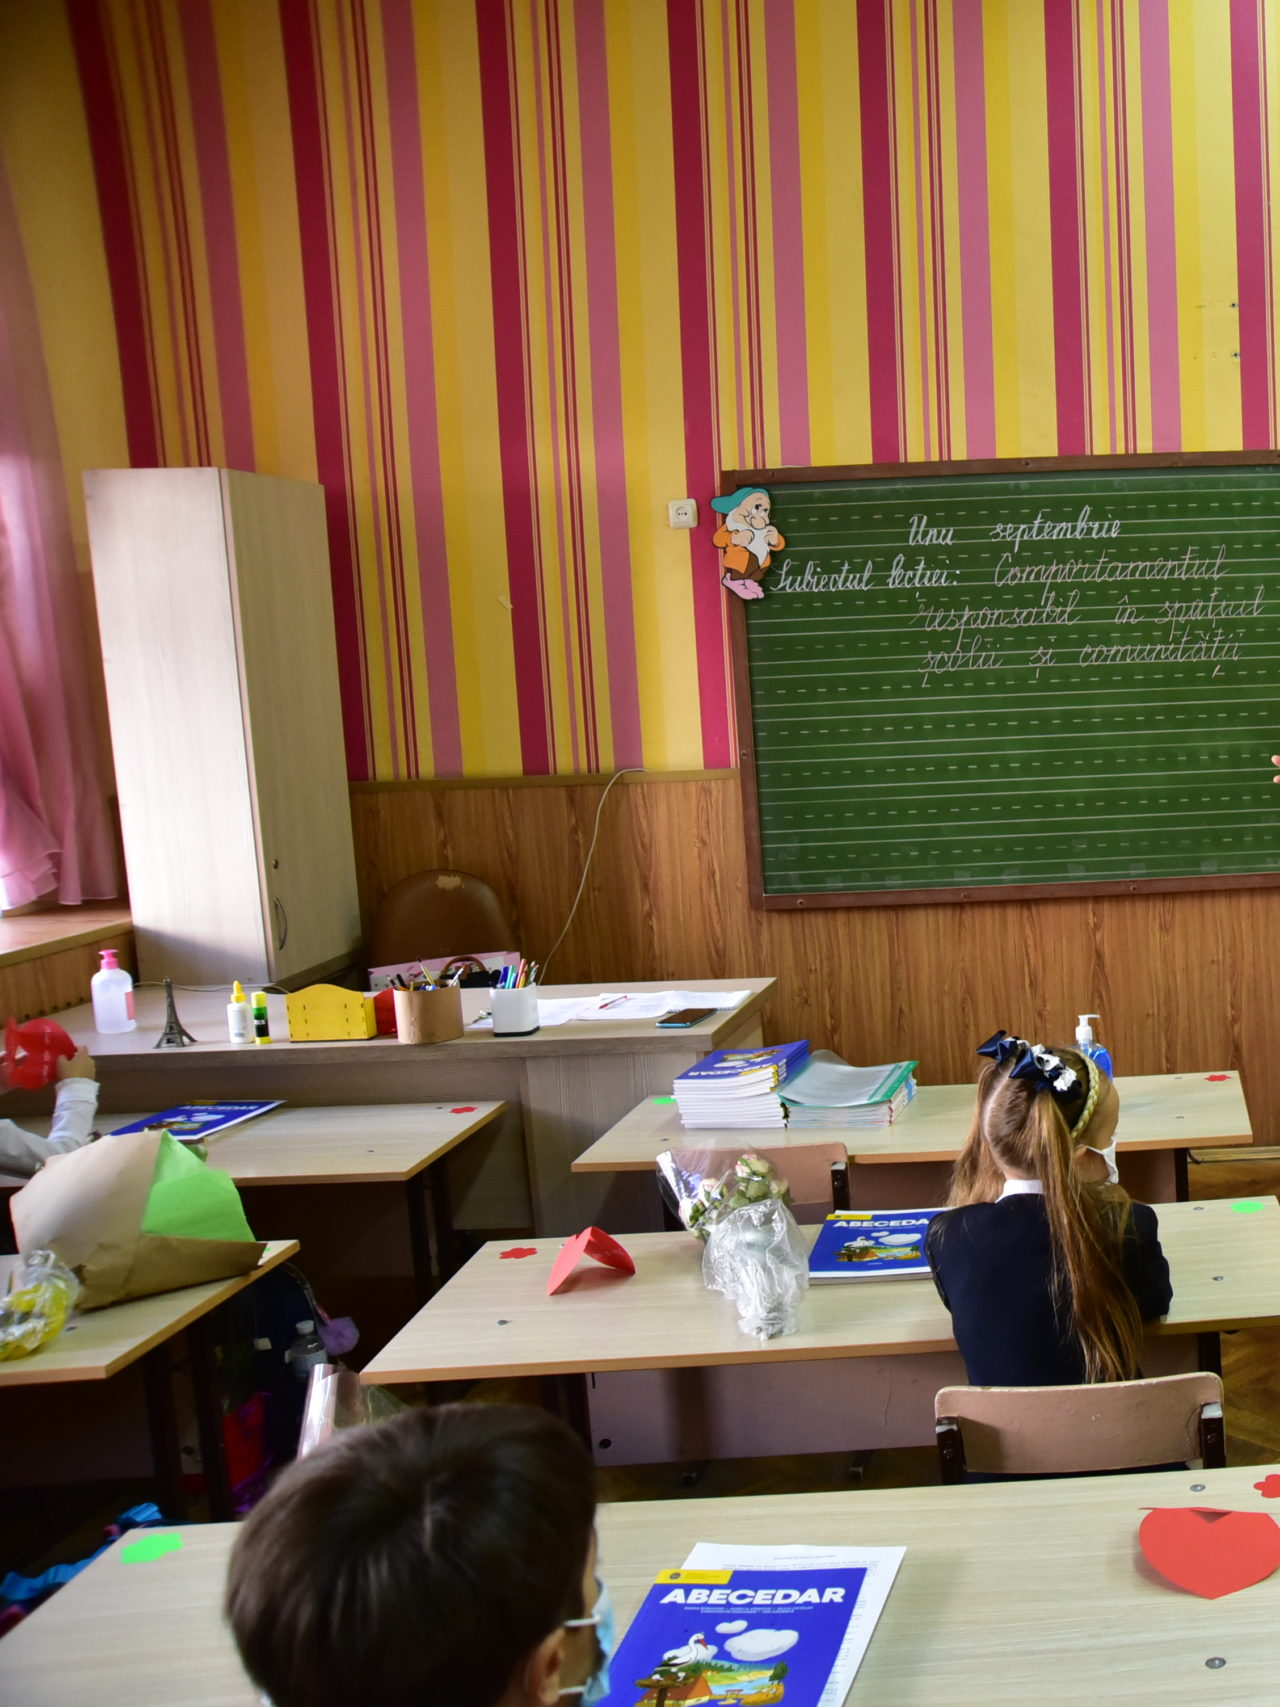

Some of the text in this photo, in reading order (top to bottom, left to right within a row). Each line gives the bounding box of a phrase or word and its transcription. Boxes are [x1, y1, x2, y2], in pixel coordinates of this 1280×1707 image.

[908, 505, 1120, 552] Unu septembrie
[770, 558, 876, 592] Subiectul
[994, 545, 1230, 605] Comportamentul
[909, 584, 1265, 650] responsabil în spațiul
[1029, 638, 1056, 678] și
[833, 1218, 930, 1228] ABECEDA
[660, 1587, 845, 1604] ABECEDAR
